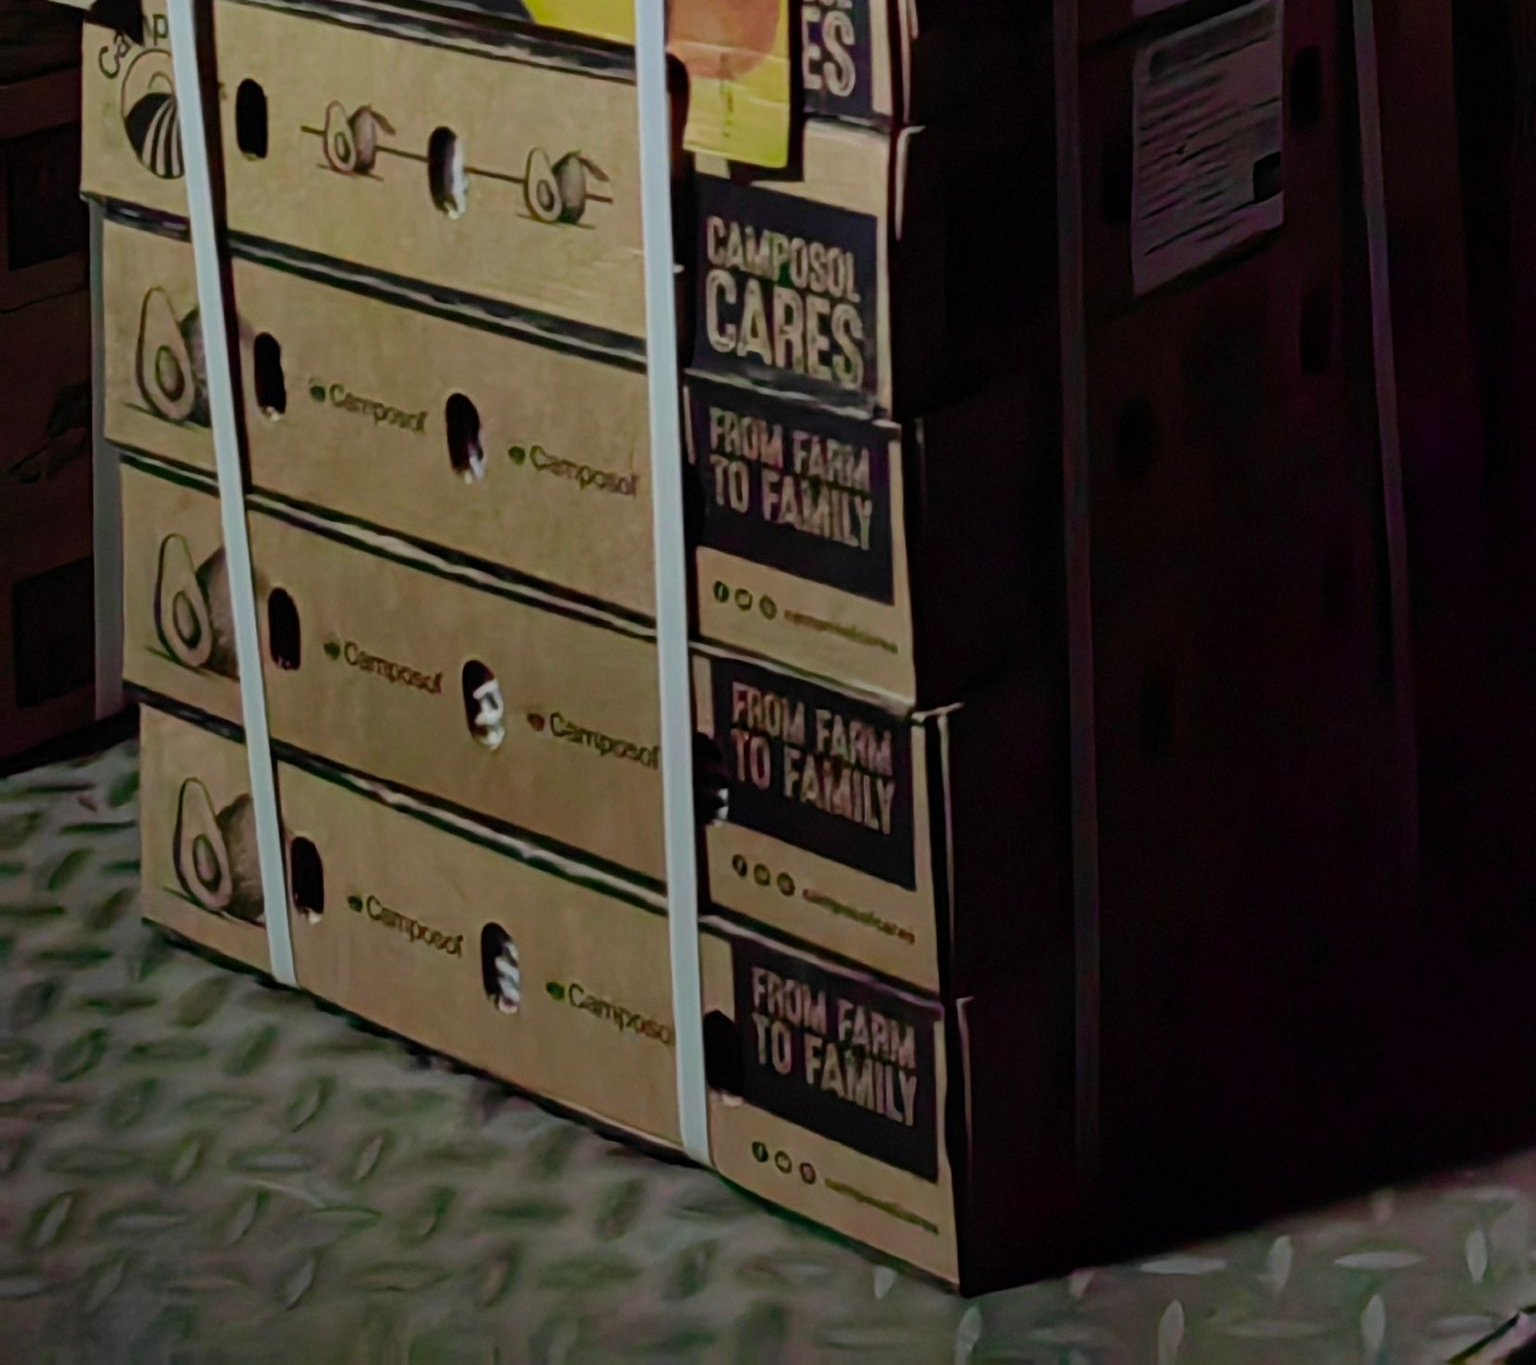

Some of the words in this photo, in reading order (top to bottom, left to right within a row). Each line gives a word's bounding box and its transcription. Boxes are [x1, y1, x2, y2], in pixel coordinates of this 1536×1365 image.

[706, 215, 862, 304] CAMPOSOL
[705, 269, 865, 391] CARES
[709, 406, 784, 470] FROM
[792, 429, 870, 494] FARM
[710, 454, 749, 514] TO
[762, 470, 874, 551] FAMILY
[732, 680, 805, 745] FROM
[815, 708, 893, 776] FARM
[731, 728, 771, 789] TO
[783, 746, 896, 836] FAMILY
[568, 982, 677, 1047] Camposo
[751, 967, 828, 1035] FROM
[837, 998, 916, 1069] FARM
[751, 1012, 793, 1075] TO
[804, 1034, 918, 1127] FAMILY
